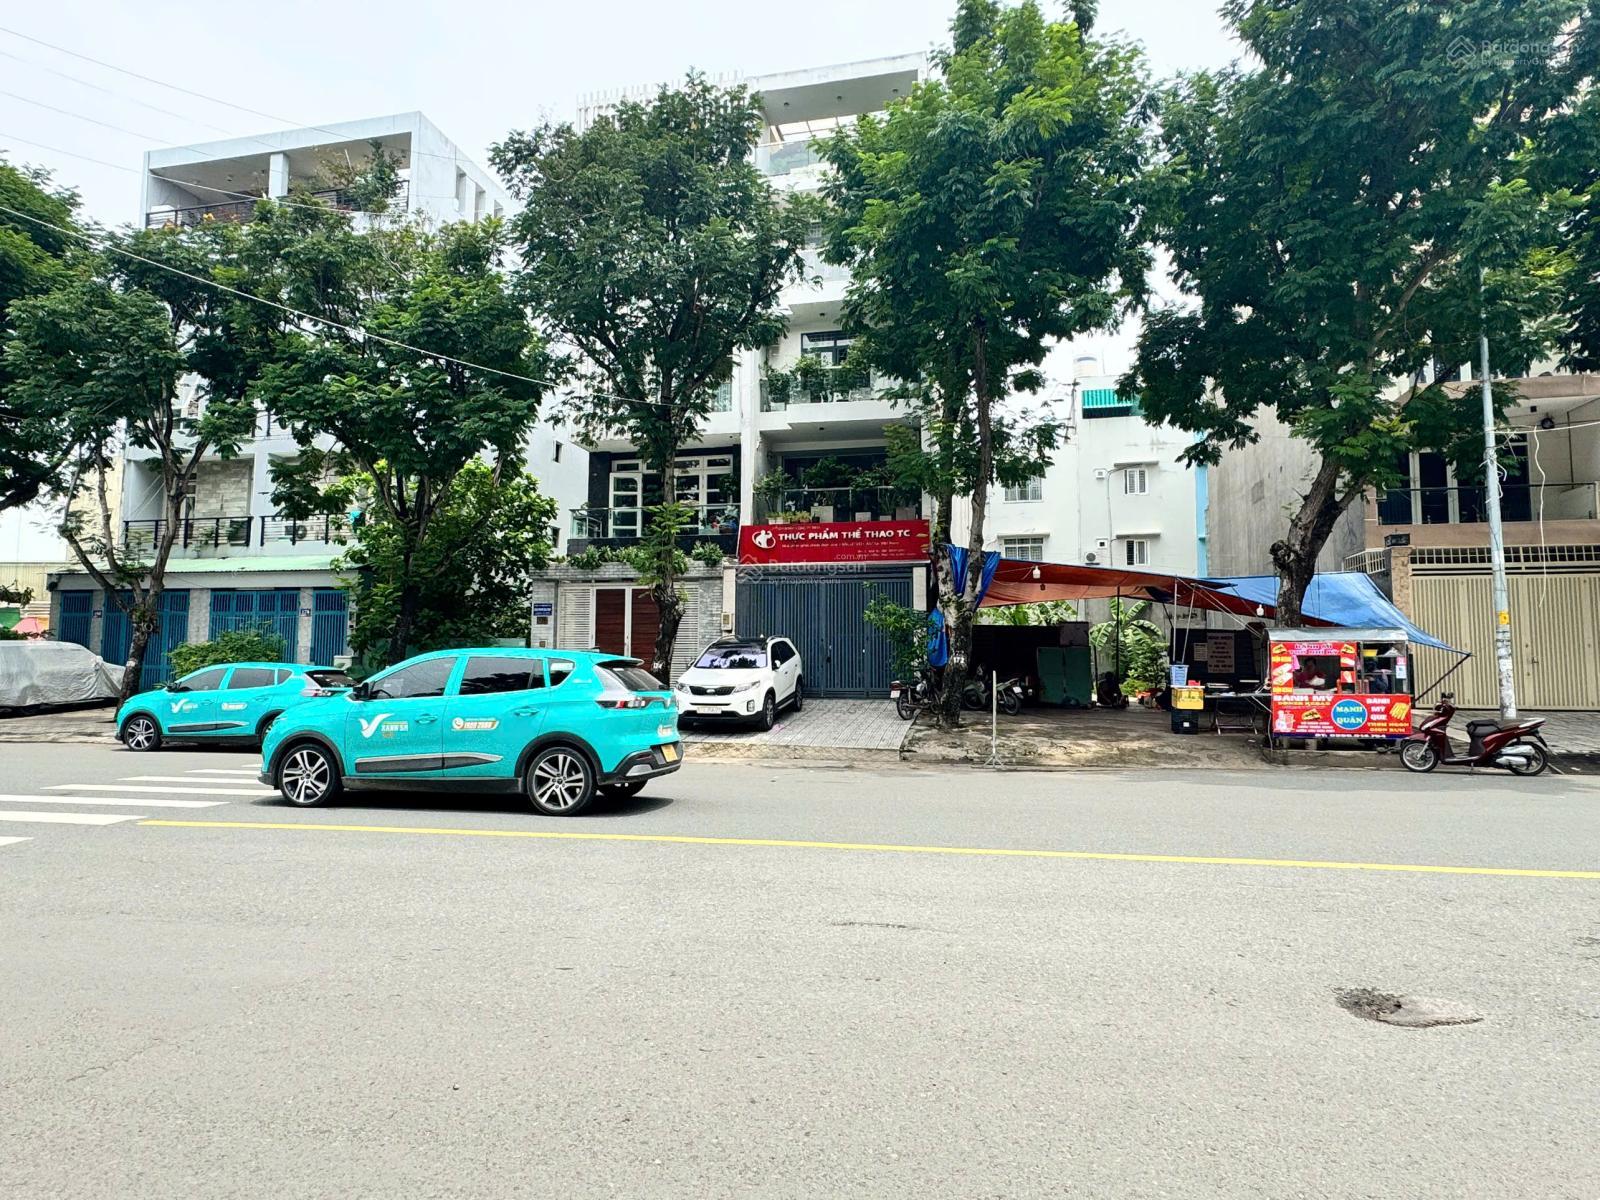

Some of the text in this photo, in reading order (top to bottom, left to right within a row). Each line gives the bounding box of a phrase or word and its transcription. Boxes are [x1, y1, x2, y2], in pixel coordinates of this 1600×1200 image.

[778, 532, 805, 543] THỰC
[808, 527, 838, 540] PHẨM
[841, 526, 862, 538] THỂ
[864, 530, 894, 538] THAO
[898, 529, 911, 537] TC
